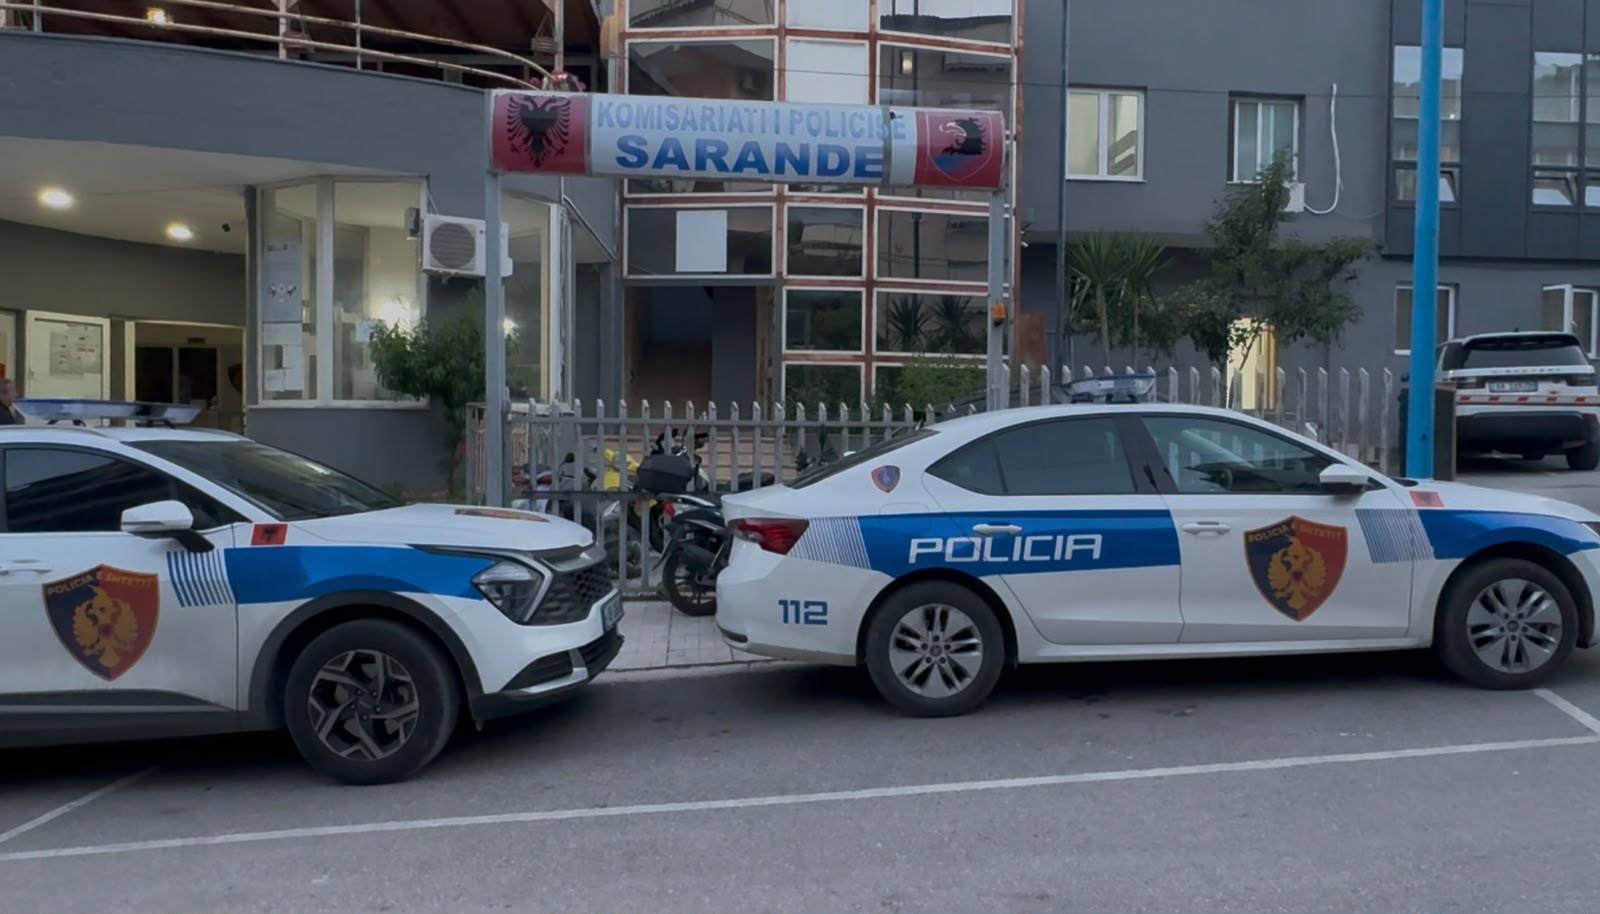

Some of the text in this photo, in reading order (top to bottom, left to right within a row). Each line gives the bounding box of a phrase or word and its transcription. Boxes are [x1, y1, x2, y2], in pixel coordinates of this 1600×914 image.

[597, 101, 766, 134] KOMISARIATI
[774, 109, 781, 135] I
[615, 134, 884, 178] SARANDE
[1248, 523, 1290, 542] POLICIA
[907, 533, 1103, 564] POLICIA
[47, 573, 94, 595] POLICIA
[778, 599, 828, 625] 112
